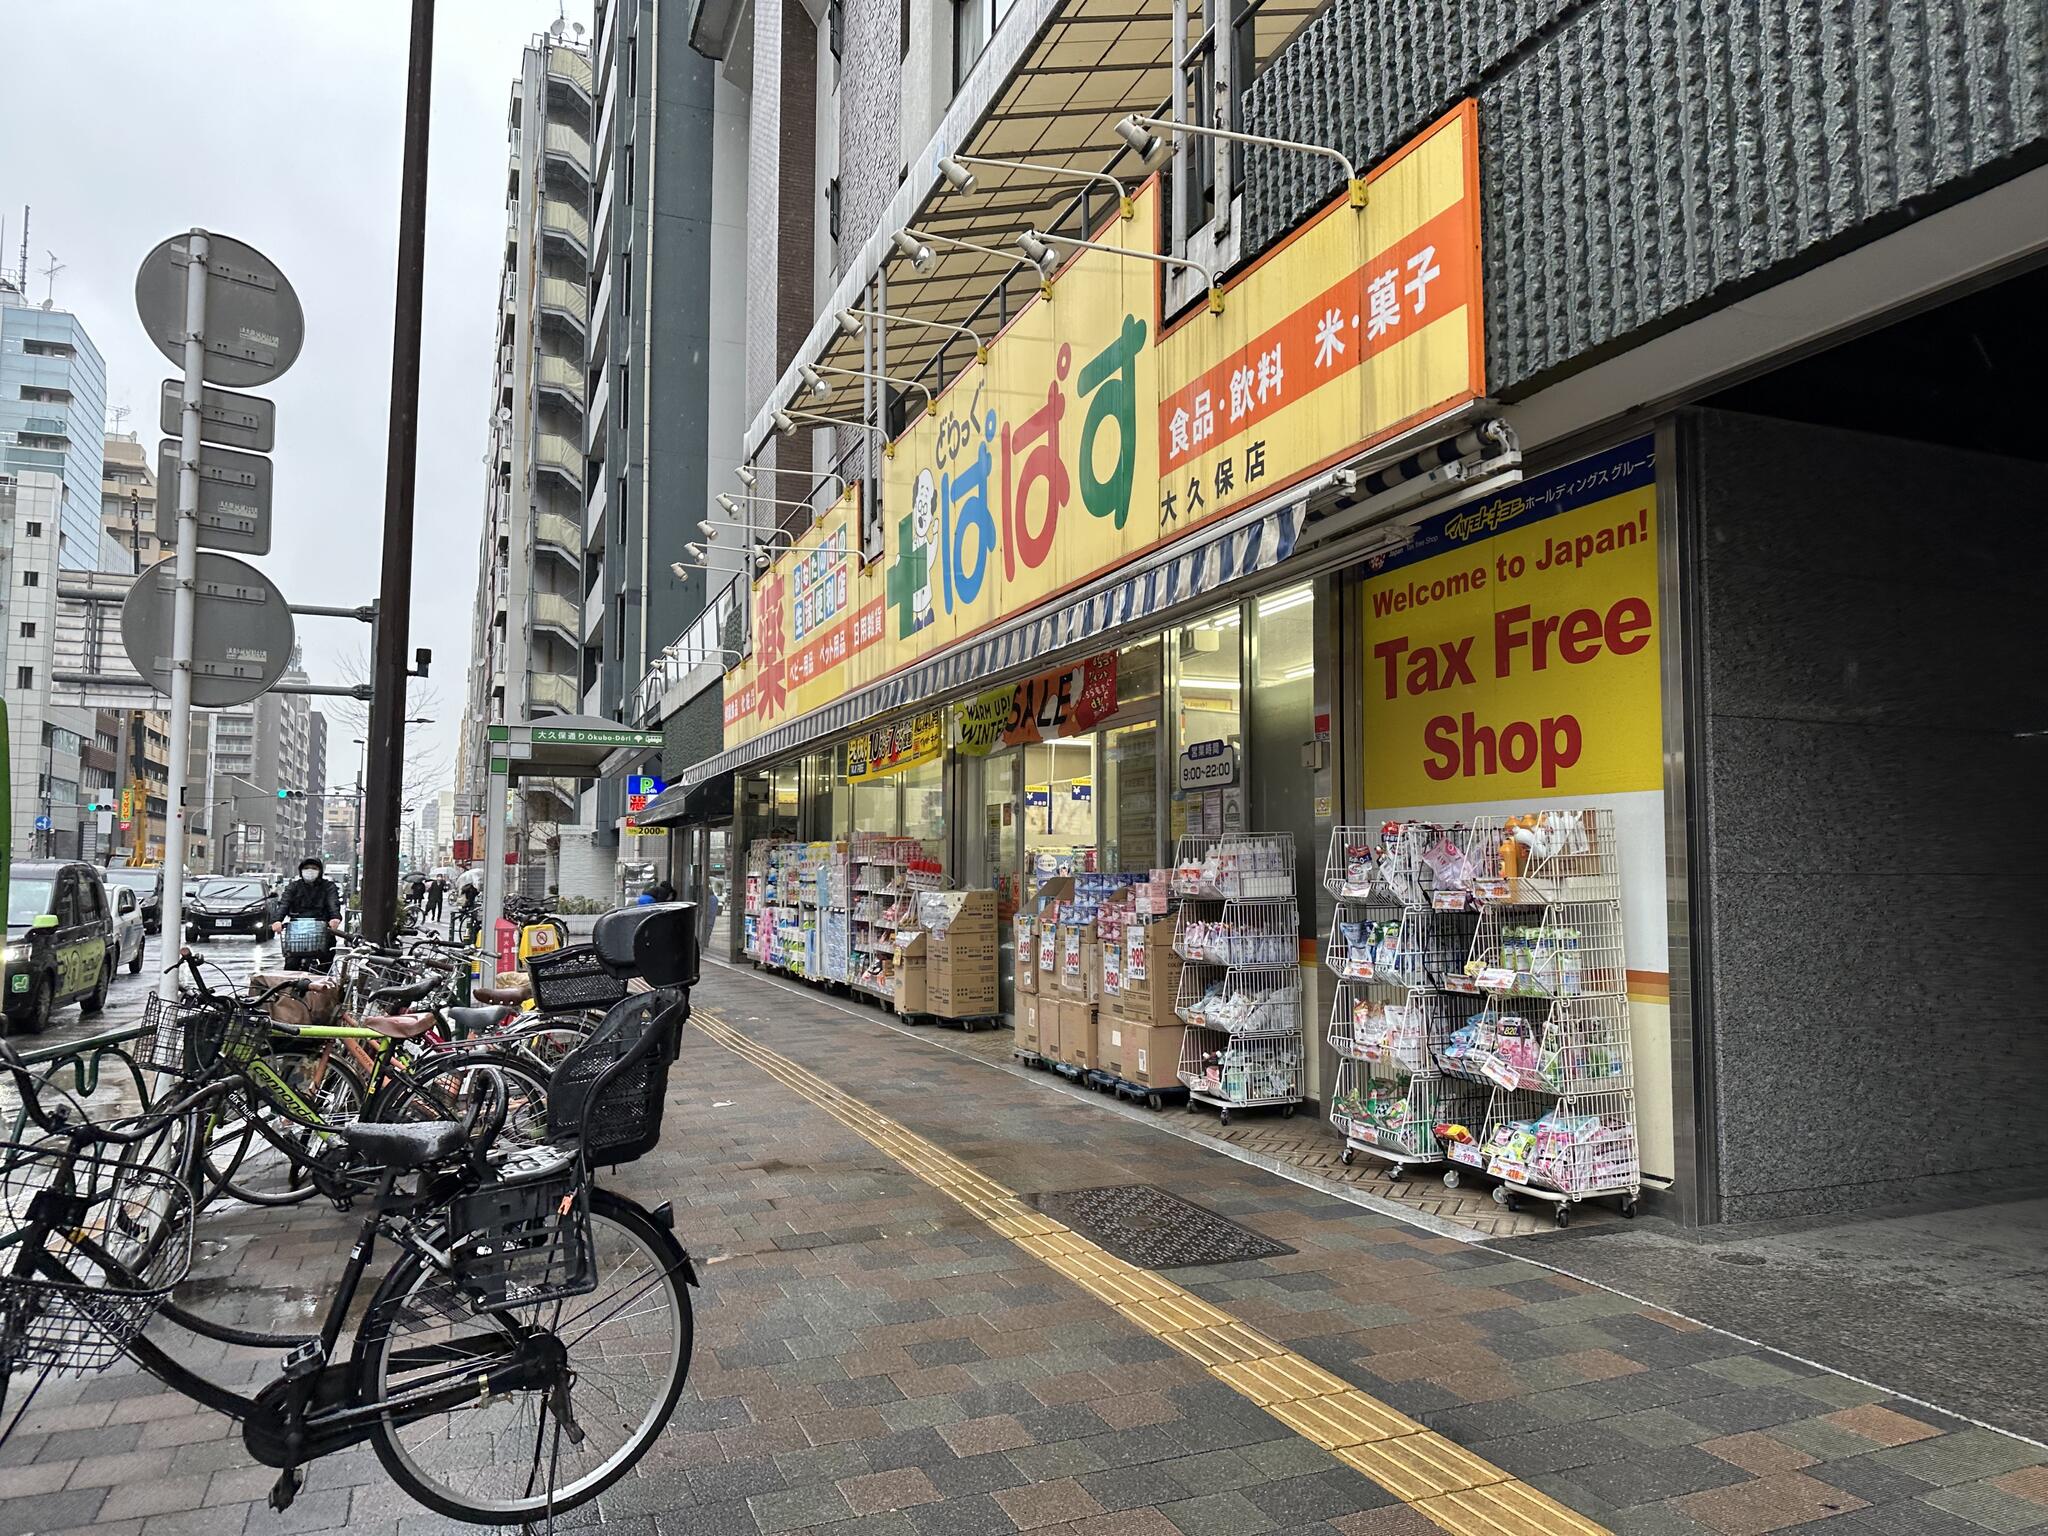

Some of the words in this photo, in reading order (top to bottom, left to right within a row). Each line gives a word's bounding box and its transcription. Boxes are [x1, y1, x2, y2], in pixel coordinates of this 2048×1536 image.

[1168, 343, 1284, 460] 食品・飲料
[940, 313, 1147, 616] ぱぱす
[1160, 440, 1267, 527] 大久保店
[1525, 469, 1609, 510] ホールディングス
[1372, 567, 1487, 618] Welcome
[1496, 553, 1526, 582] to
[1536, 509, 1649, 571] Japan!
[756, 573, 787, 722] 薬
[853, 605, 882, 647] 日用雑貨
[1374, 636, 1477, 701] Tax
[1494, 597, 1653, 678] Free
[538, 731, 585, 741] 大久保通り
[966, 704, 992, 723] WARM
[993, 695, 1010, 717] UP!
[1005, 672, 1073, 732] SALE
[1423, 711, 1583, 789] Shop
[640, 777, 654, 794] P
[239, 1103, 257, 1121] huit
